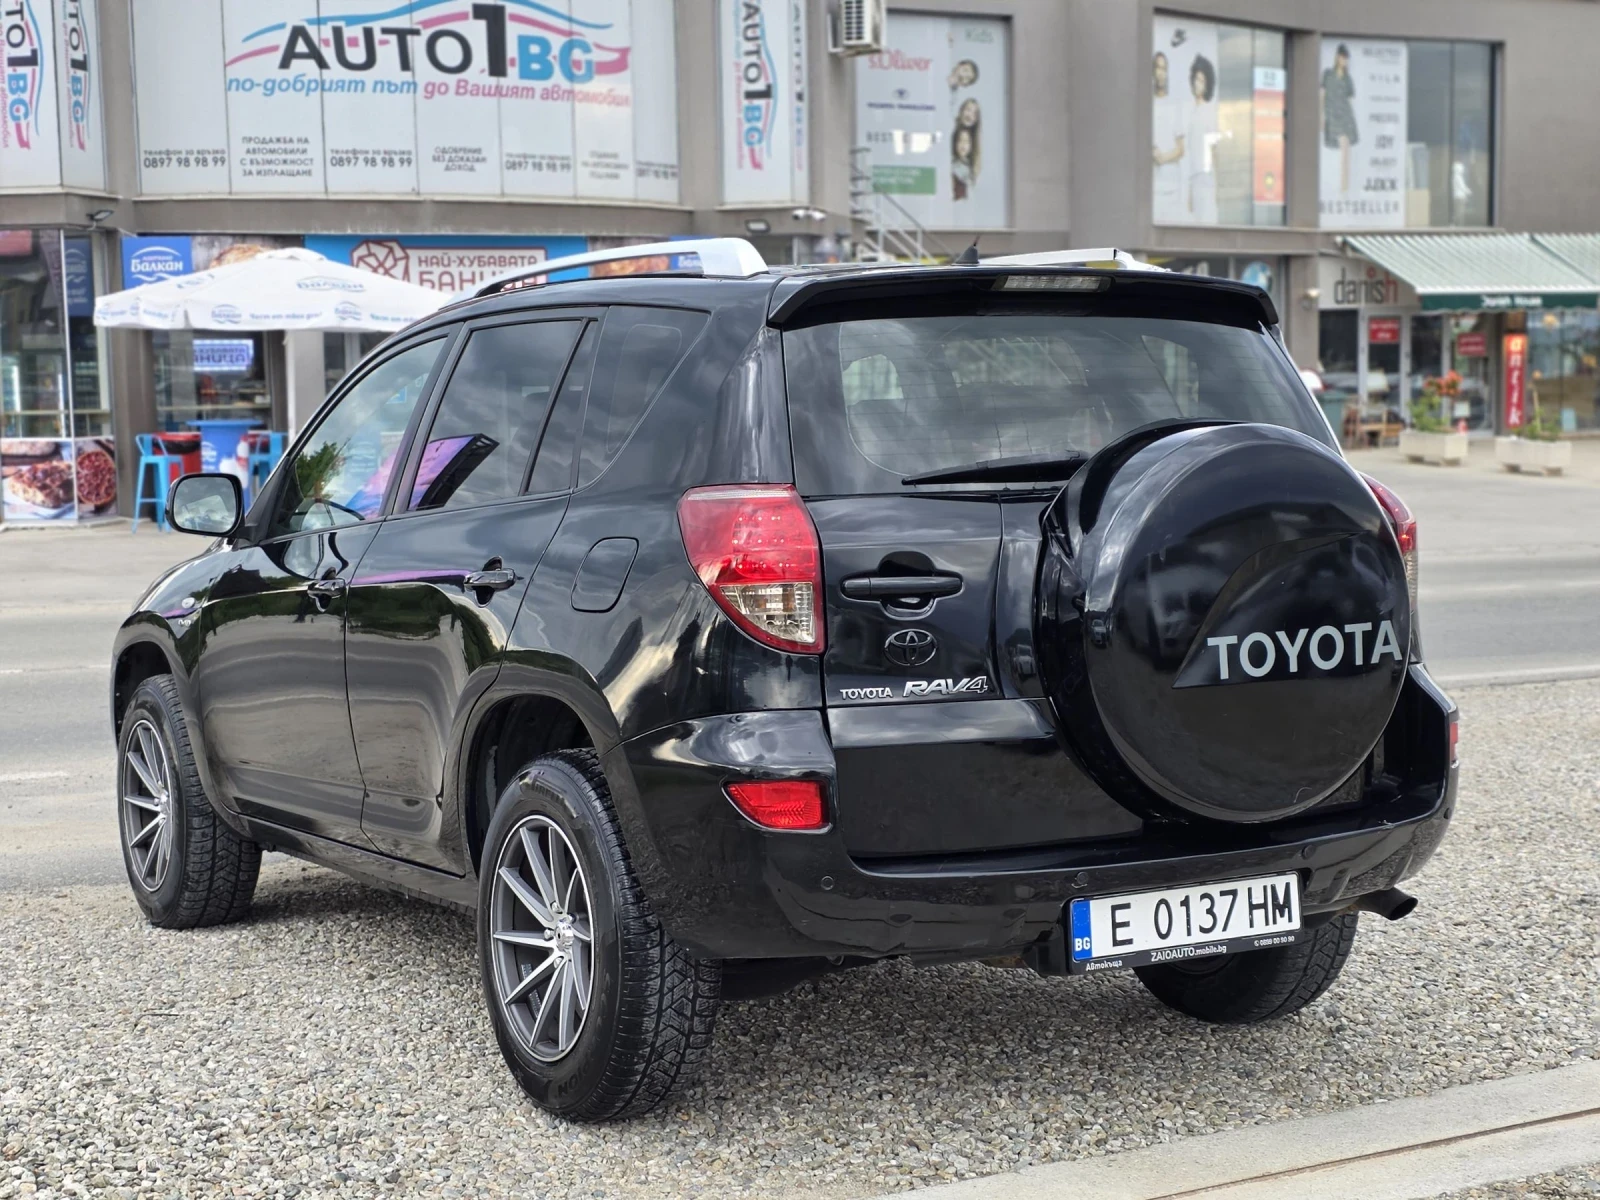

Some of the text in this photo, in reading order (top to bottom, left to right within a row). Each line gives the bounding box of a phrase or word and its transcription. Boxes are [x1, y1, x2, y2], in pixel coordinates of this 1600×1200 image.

[228, 73, 366, 97] по-добрият
[372, 79, 418, 95] път
[423, 80, 449, 99] до
[455, 79, 535, 99] Вашият
[242, 136, 310, 145] ПРОДАЖБА НА
[245, 147, 308, 156] АВТОМОБИЛИ
[143, 156, 227, 168] 0897 98 98 99
[240, 158, 314, 166] С ВЪЗМОЖНОСТ
[330, 156, 413, 168] 0897 98 98 99
[432, 155, 446, 163] БЕЗ
[242, 169, 254, 177] ЗА
[131, 258, 184, 273] Балкан
[418, 252, 537, 267] НАЙ-ХУБАВАТА
[1206, 619, 1403, 680] TOYOTA
[840, 676, 988, 700] TOYOTA RAV4
[1111, 881, 1293, 947] E 0137 HM
[1075, 937, 1091, 951] BG
